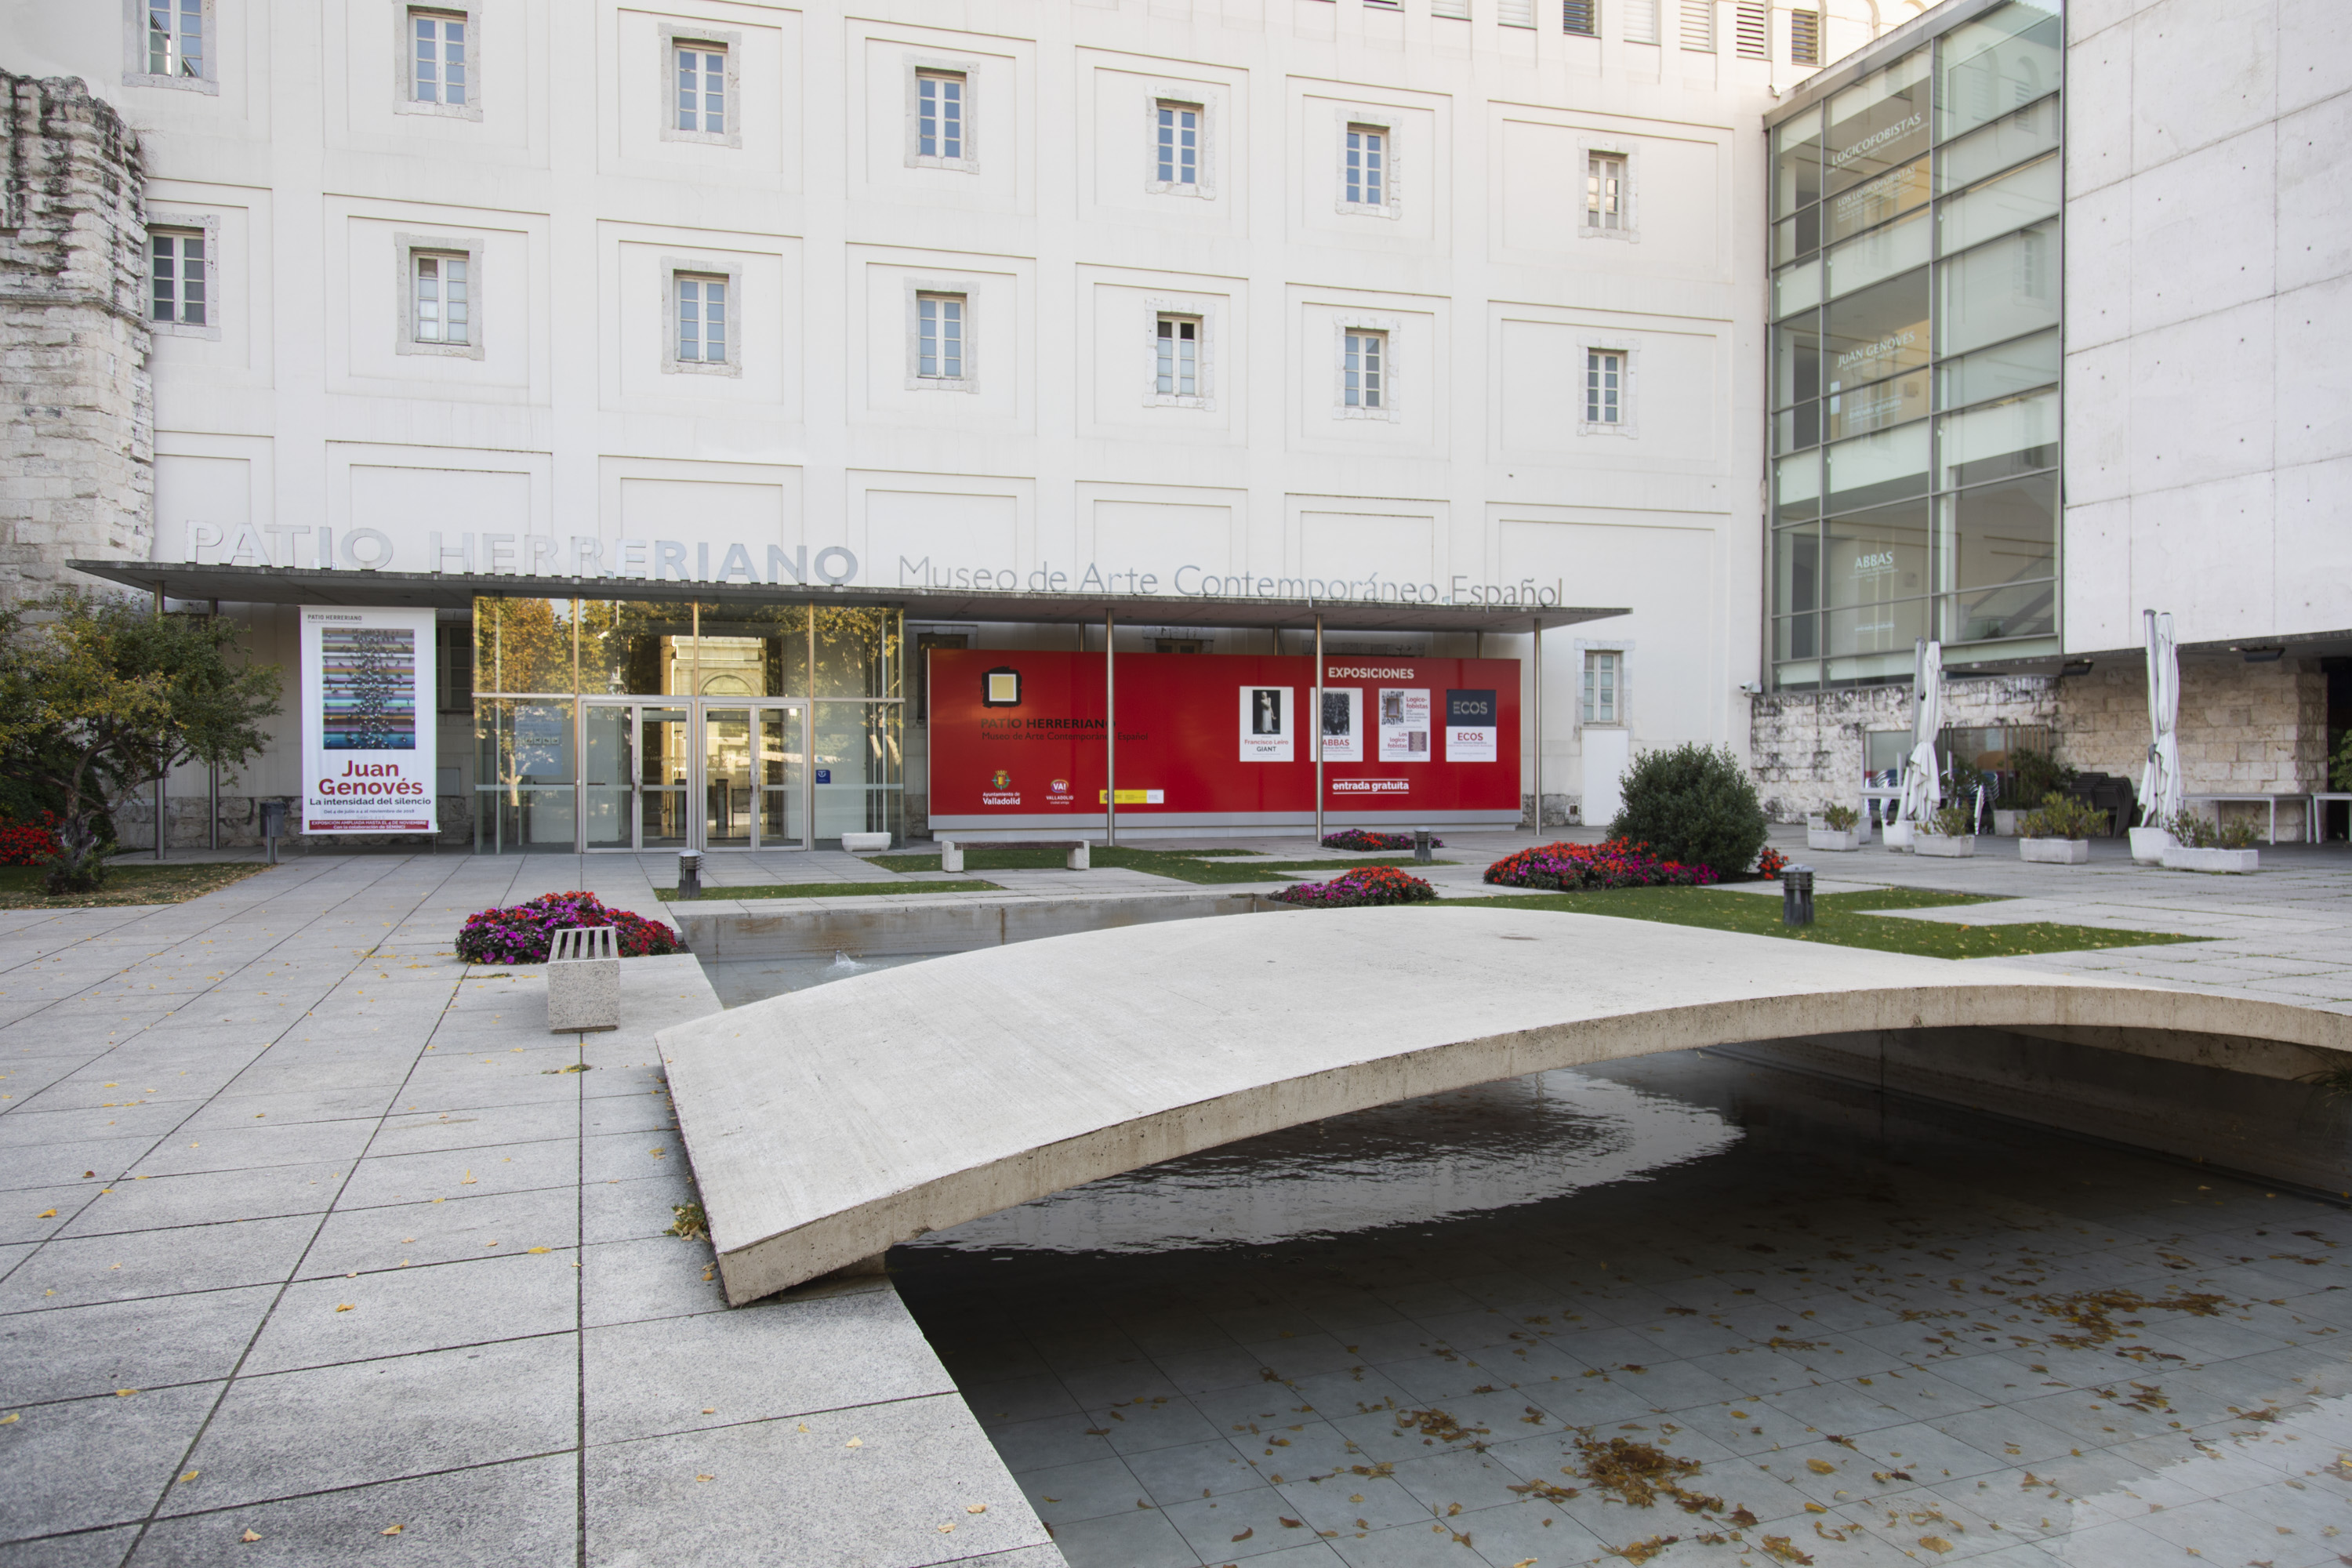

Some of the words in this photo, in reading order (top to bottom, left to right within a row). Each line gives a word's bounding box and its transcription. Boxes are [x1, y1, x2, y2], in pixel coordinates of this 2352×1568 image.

[1832, 112, 1921, 165] LOGICOFOBISTAS
[1837, 196, 1852, 207] LOS
[1837, 348, 1864, 368] JUAN
[1866, 330, 1915, 357] GENOVÉS
[184, 520, 394, 571] PATIO
[430, 531, 858, 586] HERRERIANO
[1855, 551, 1893, 570] ABBAS
[899, 555, 1018, 590] Museo
[1028, 561, 1068, 592] de
[1078, 562, 1158, 594] Arte
[1174, 564, 1439, 608] Contemporáneo
[1452, 575, 1563, 613] Español
[1328, 667, 1414, 679] EXPOSICIONES
[1453, 701, 1488, 715] ECOS
[981, 718, 1022, 729] PATIO
[1117, 731, 1149, 742] Español
[1457, 732, 1483, 741] ECOS
[342, 760, 399, 777] Juan
[318, 778, 423, 796] Genovés
[1332, 781, 1370, 790] entrada
[1371, 781, 1410, 792] gratuita
